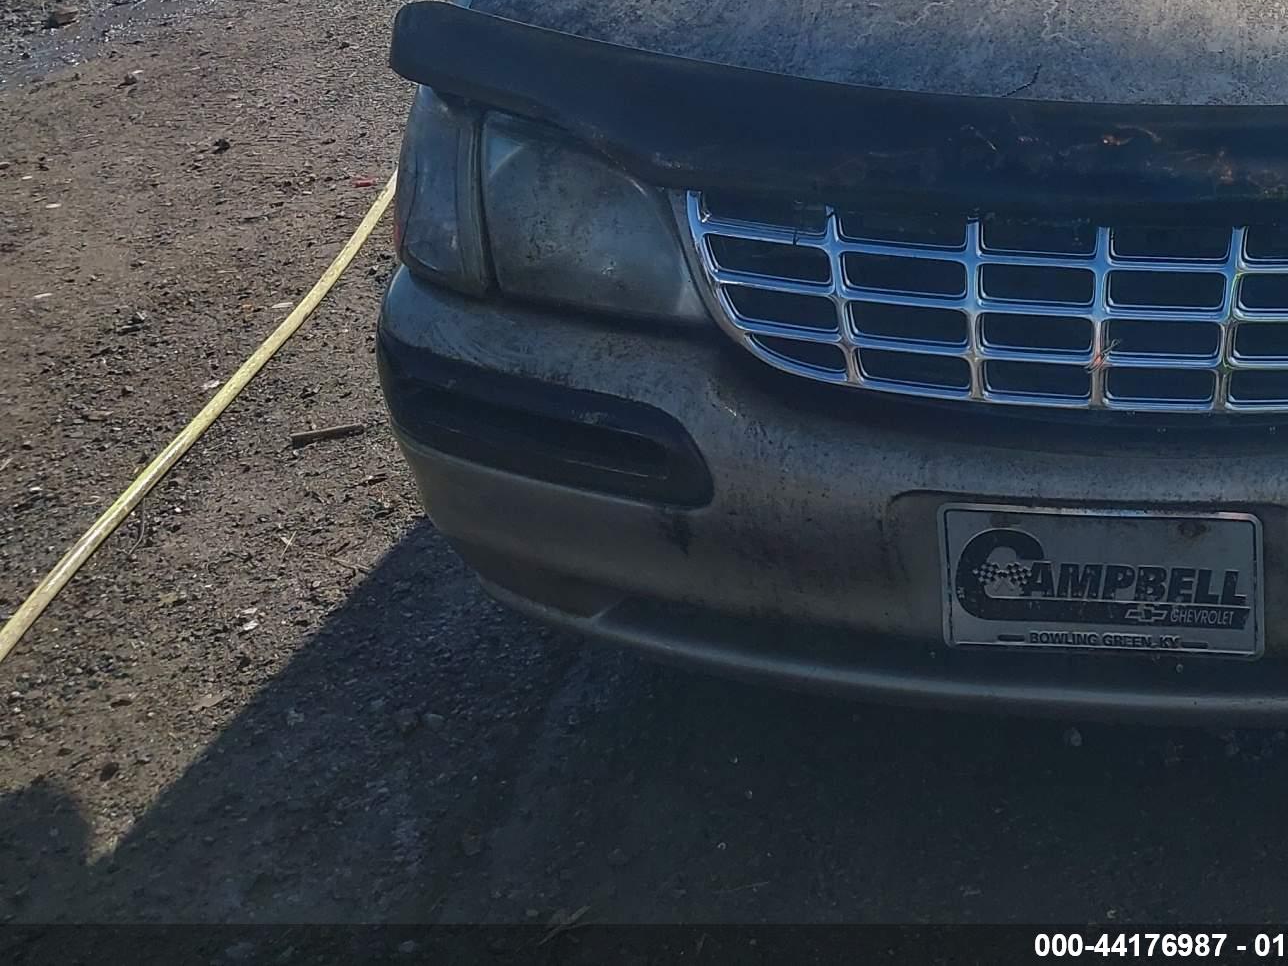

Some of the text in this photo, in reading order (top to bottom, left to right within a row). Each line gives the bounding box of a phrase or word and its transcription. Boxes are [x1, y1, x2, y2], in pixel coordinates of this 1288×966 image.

[955, 528, 1250, 626] CAMPBELL
[1170, 608, 1235, 626] CHEVROLET
[1029, 631, 1098, 647] BOWLING
[1159, 635, 1181, 649] KY
